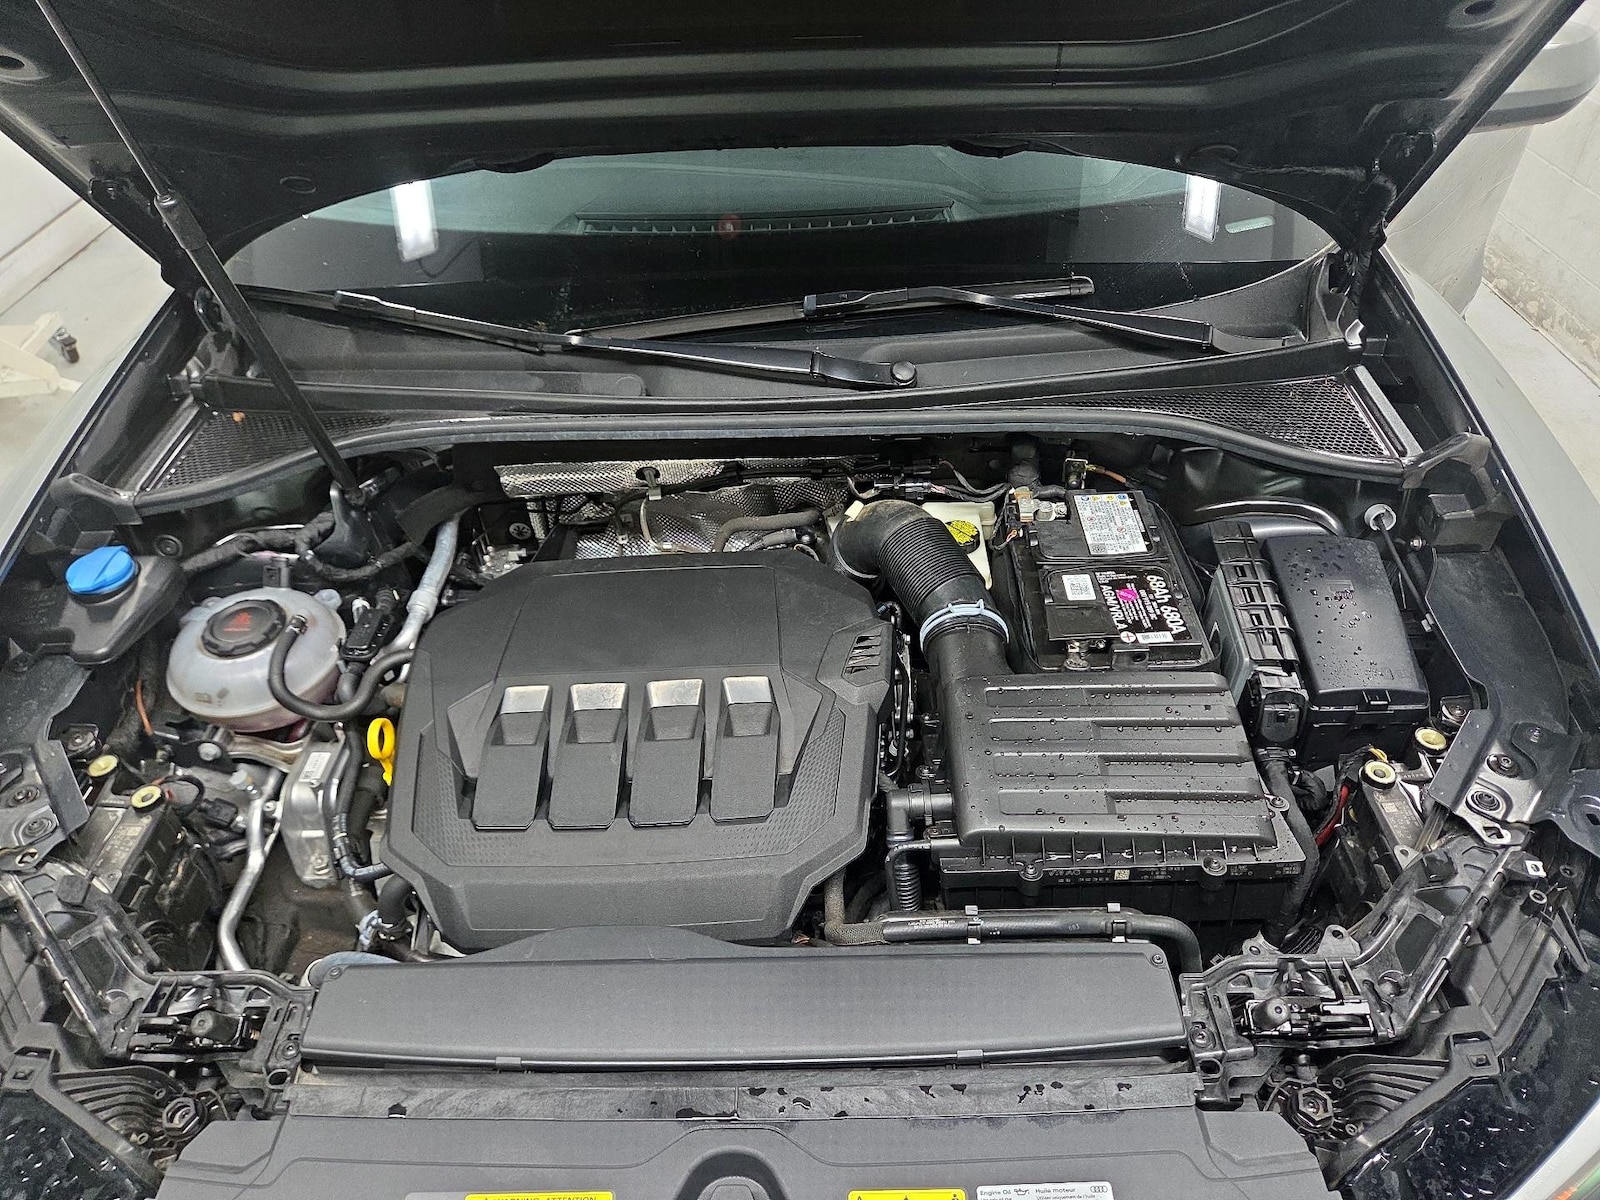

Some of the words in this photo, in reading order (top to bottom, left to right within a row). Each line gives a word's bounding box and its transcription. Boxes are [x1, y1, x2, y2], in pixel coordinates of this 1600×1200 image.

[1100, 585, 1128, 629] AGM/VRLA
[1147, 575, 1171, 603] 68Ah
[1160, 606, 1187, 634] 680A
